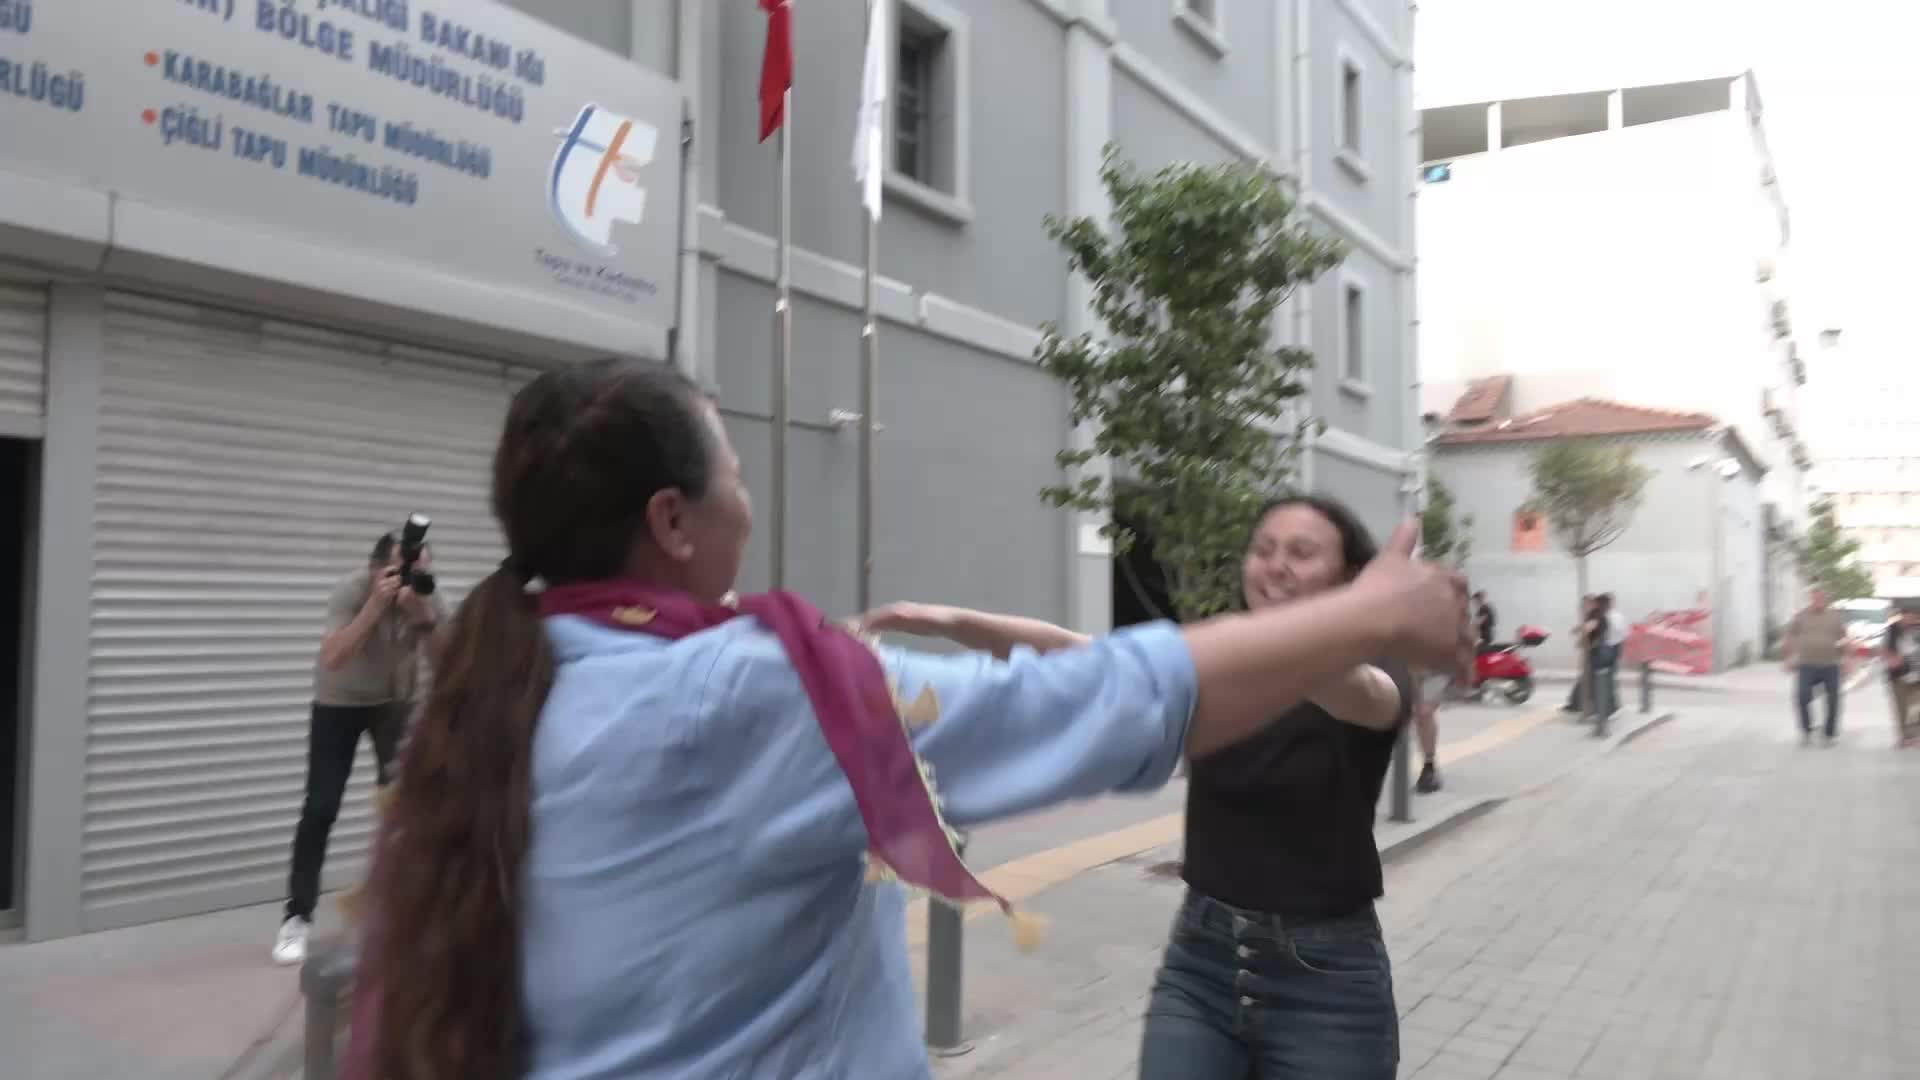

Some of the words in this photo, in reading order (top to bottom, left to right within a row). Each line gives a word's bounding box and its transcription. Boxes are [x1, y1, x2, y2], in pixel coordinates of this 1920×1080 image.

[162, 48, 314, 124] KARABAĞLAR
[326, 103, 377, 144] TAPU
[383, 120, 492, 180] MÜDÜRLÜĞÜ
[256, 0, 354, 62] BÖLGE
[368, 39, 524, 124] MÜDÜRLÜĞÜ
[161, 103, 224, 151] ÇİĞLİ
[231, 126, 289, 169] TAPU
[297, 144, 419, 207] MÜDÜRLÜĞÜ
